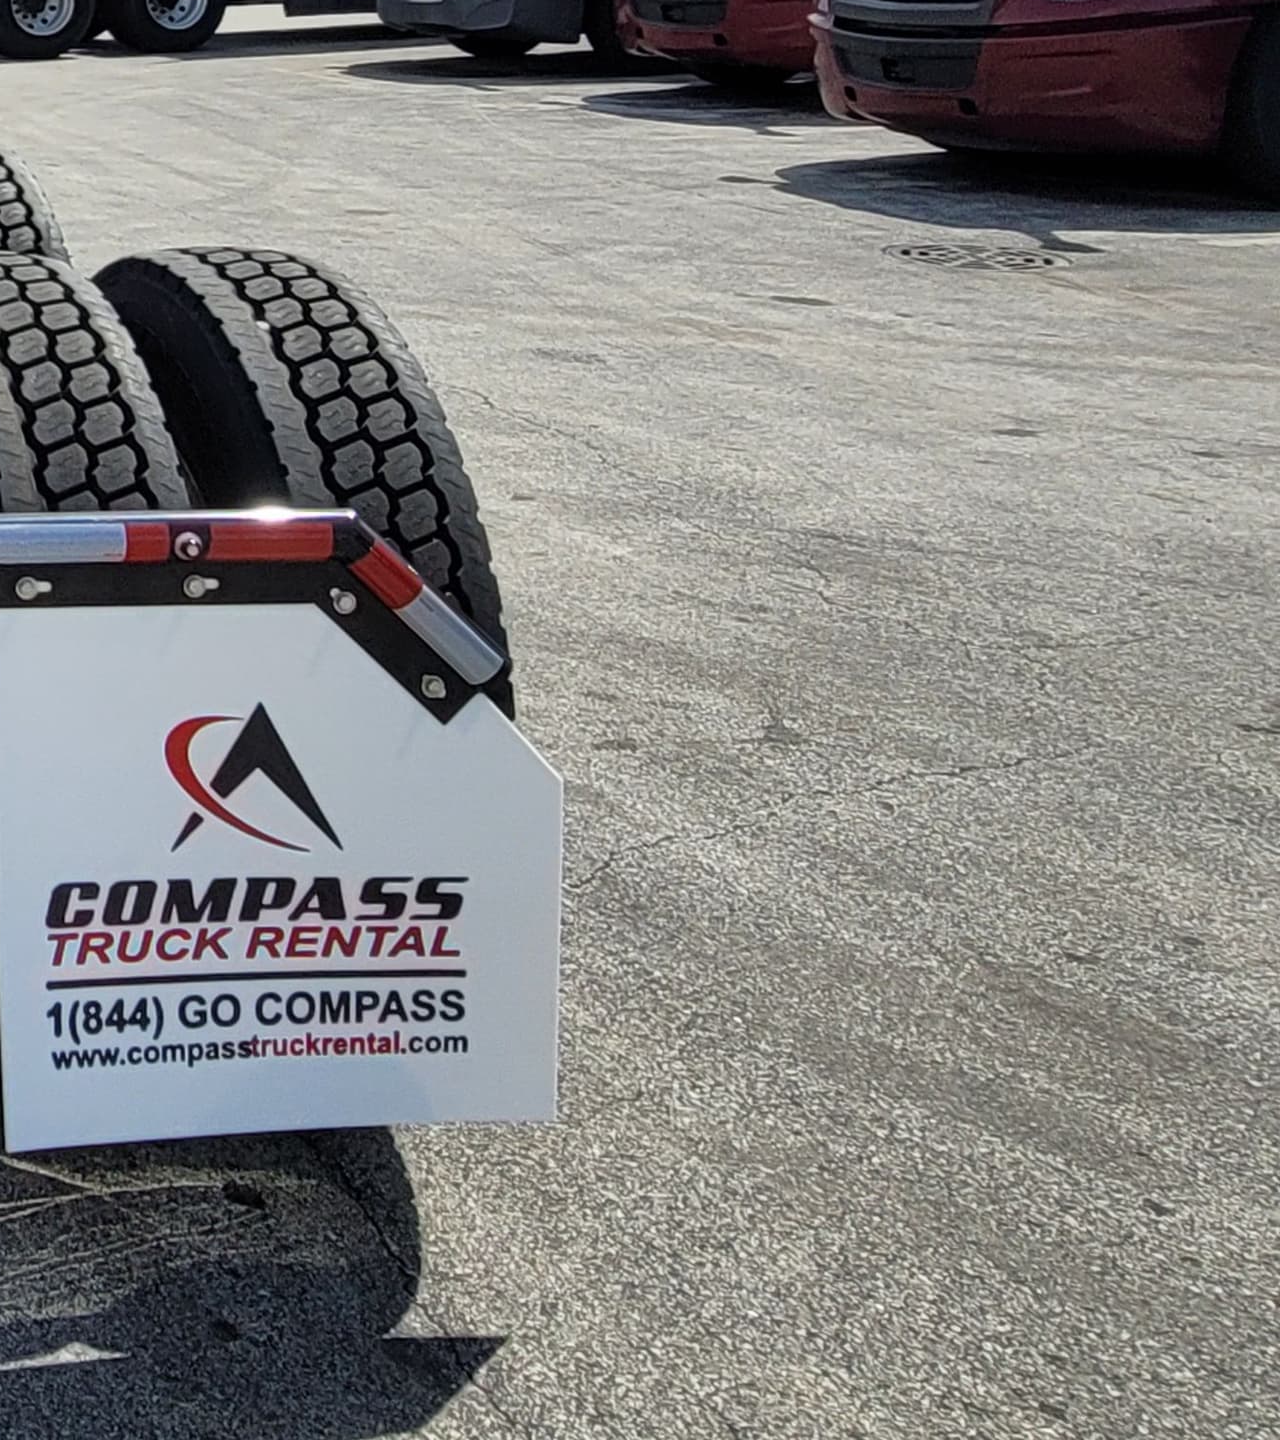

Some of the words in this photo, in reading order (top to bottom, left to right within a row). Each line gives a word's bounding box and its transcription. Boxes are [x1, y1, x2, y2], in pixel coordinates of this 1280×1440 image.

[45, 876, 469, 929] COMPASS
[46, 927, 233, 966] TRUCK
[245, 926, 461, 959] RENTAL
[46, 996, 165, 1045] 1(844)
[177, 993, 242, 1028] GO
[254, 990, 467, 1025] COMPASS
[51, 1031, 469, 1070] www.compasstruckrental.com
